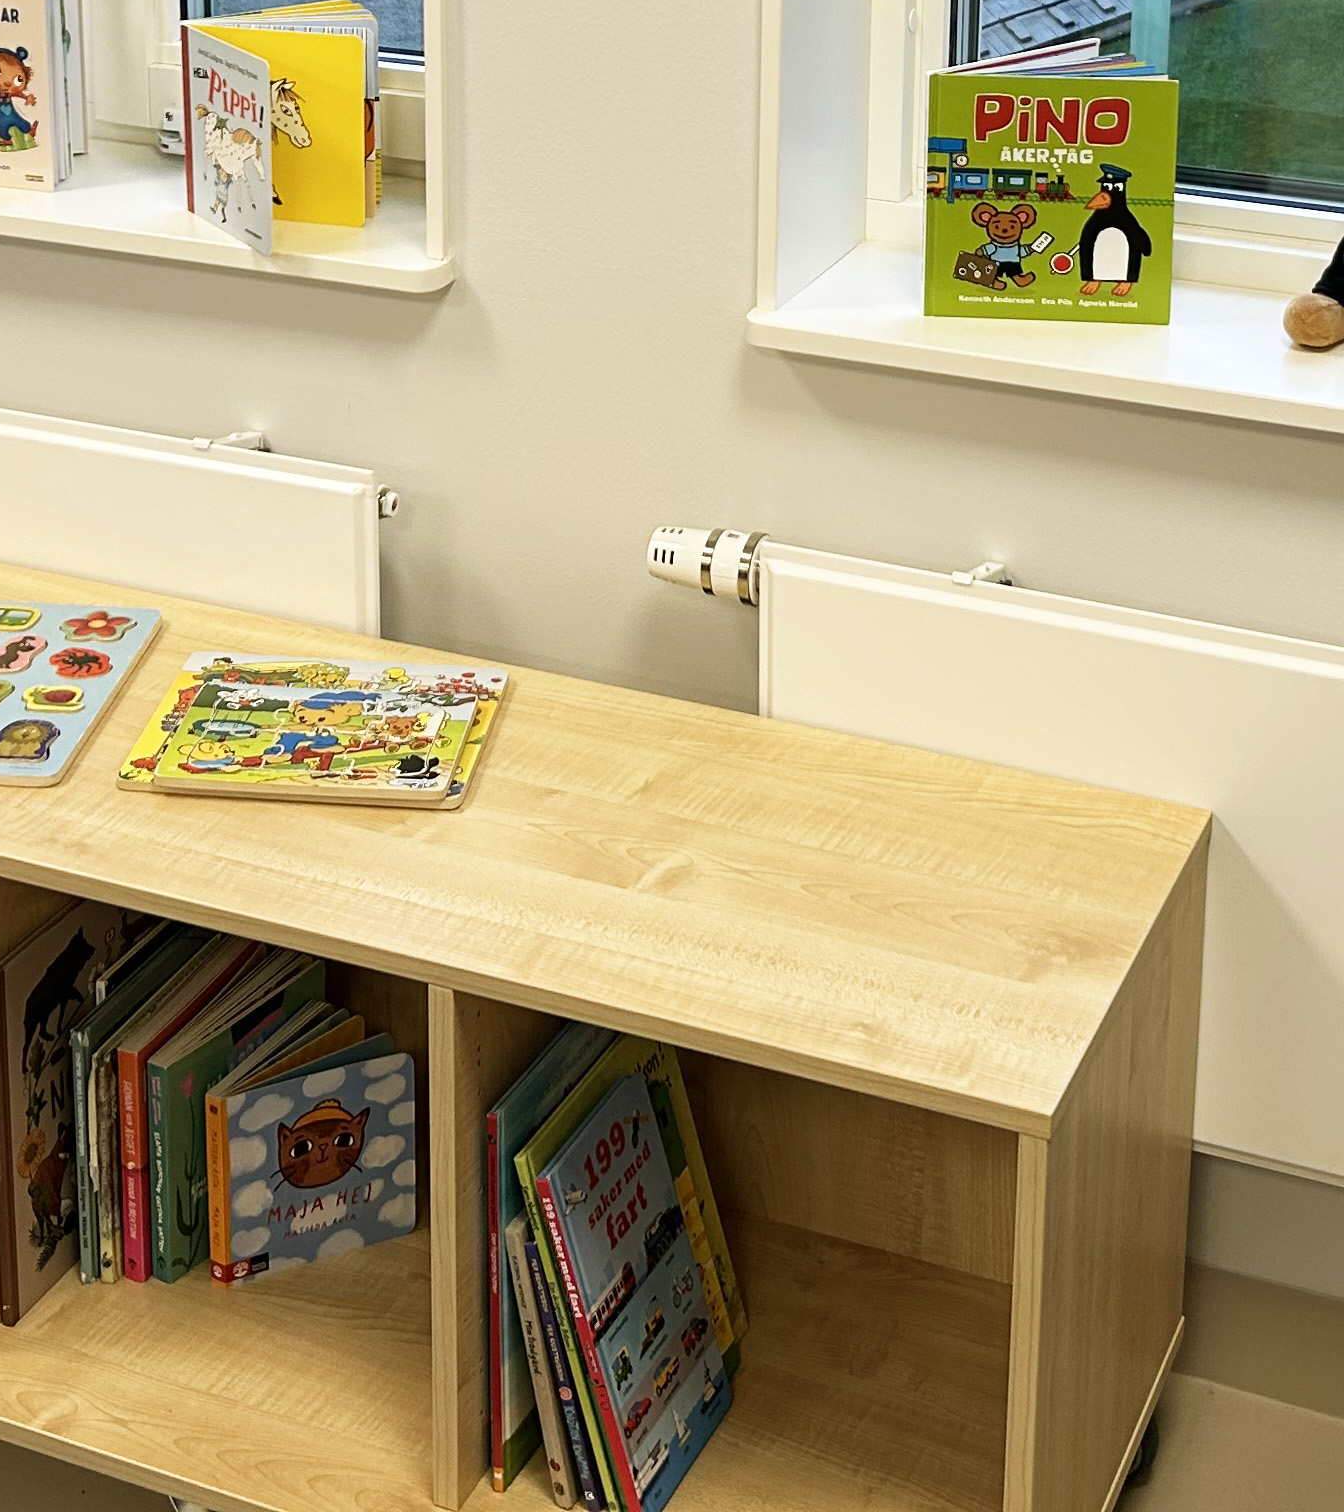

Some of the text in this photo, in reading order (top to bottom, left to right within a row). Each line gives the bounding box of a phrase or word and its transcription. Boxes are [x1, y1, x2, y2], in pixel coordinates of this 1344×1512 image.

[1000, 147, 1093, 164] ÅKER TÅG
[584, 1121, 625, 1191] 199
[588, 1141, 651, 1230] saker med
[267, 1182, 372, 1225] MAJA HEJ
[605, 1180, 648, 1252] fart
[541, 1196, 585, 1320] 199 saker med fart
